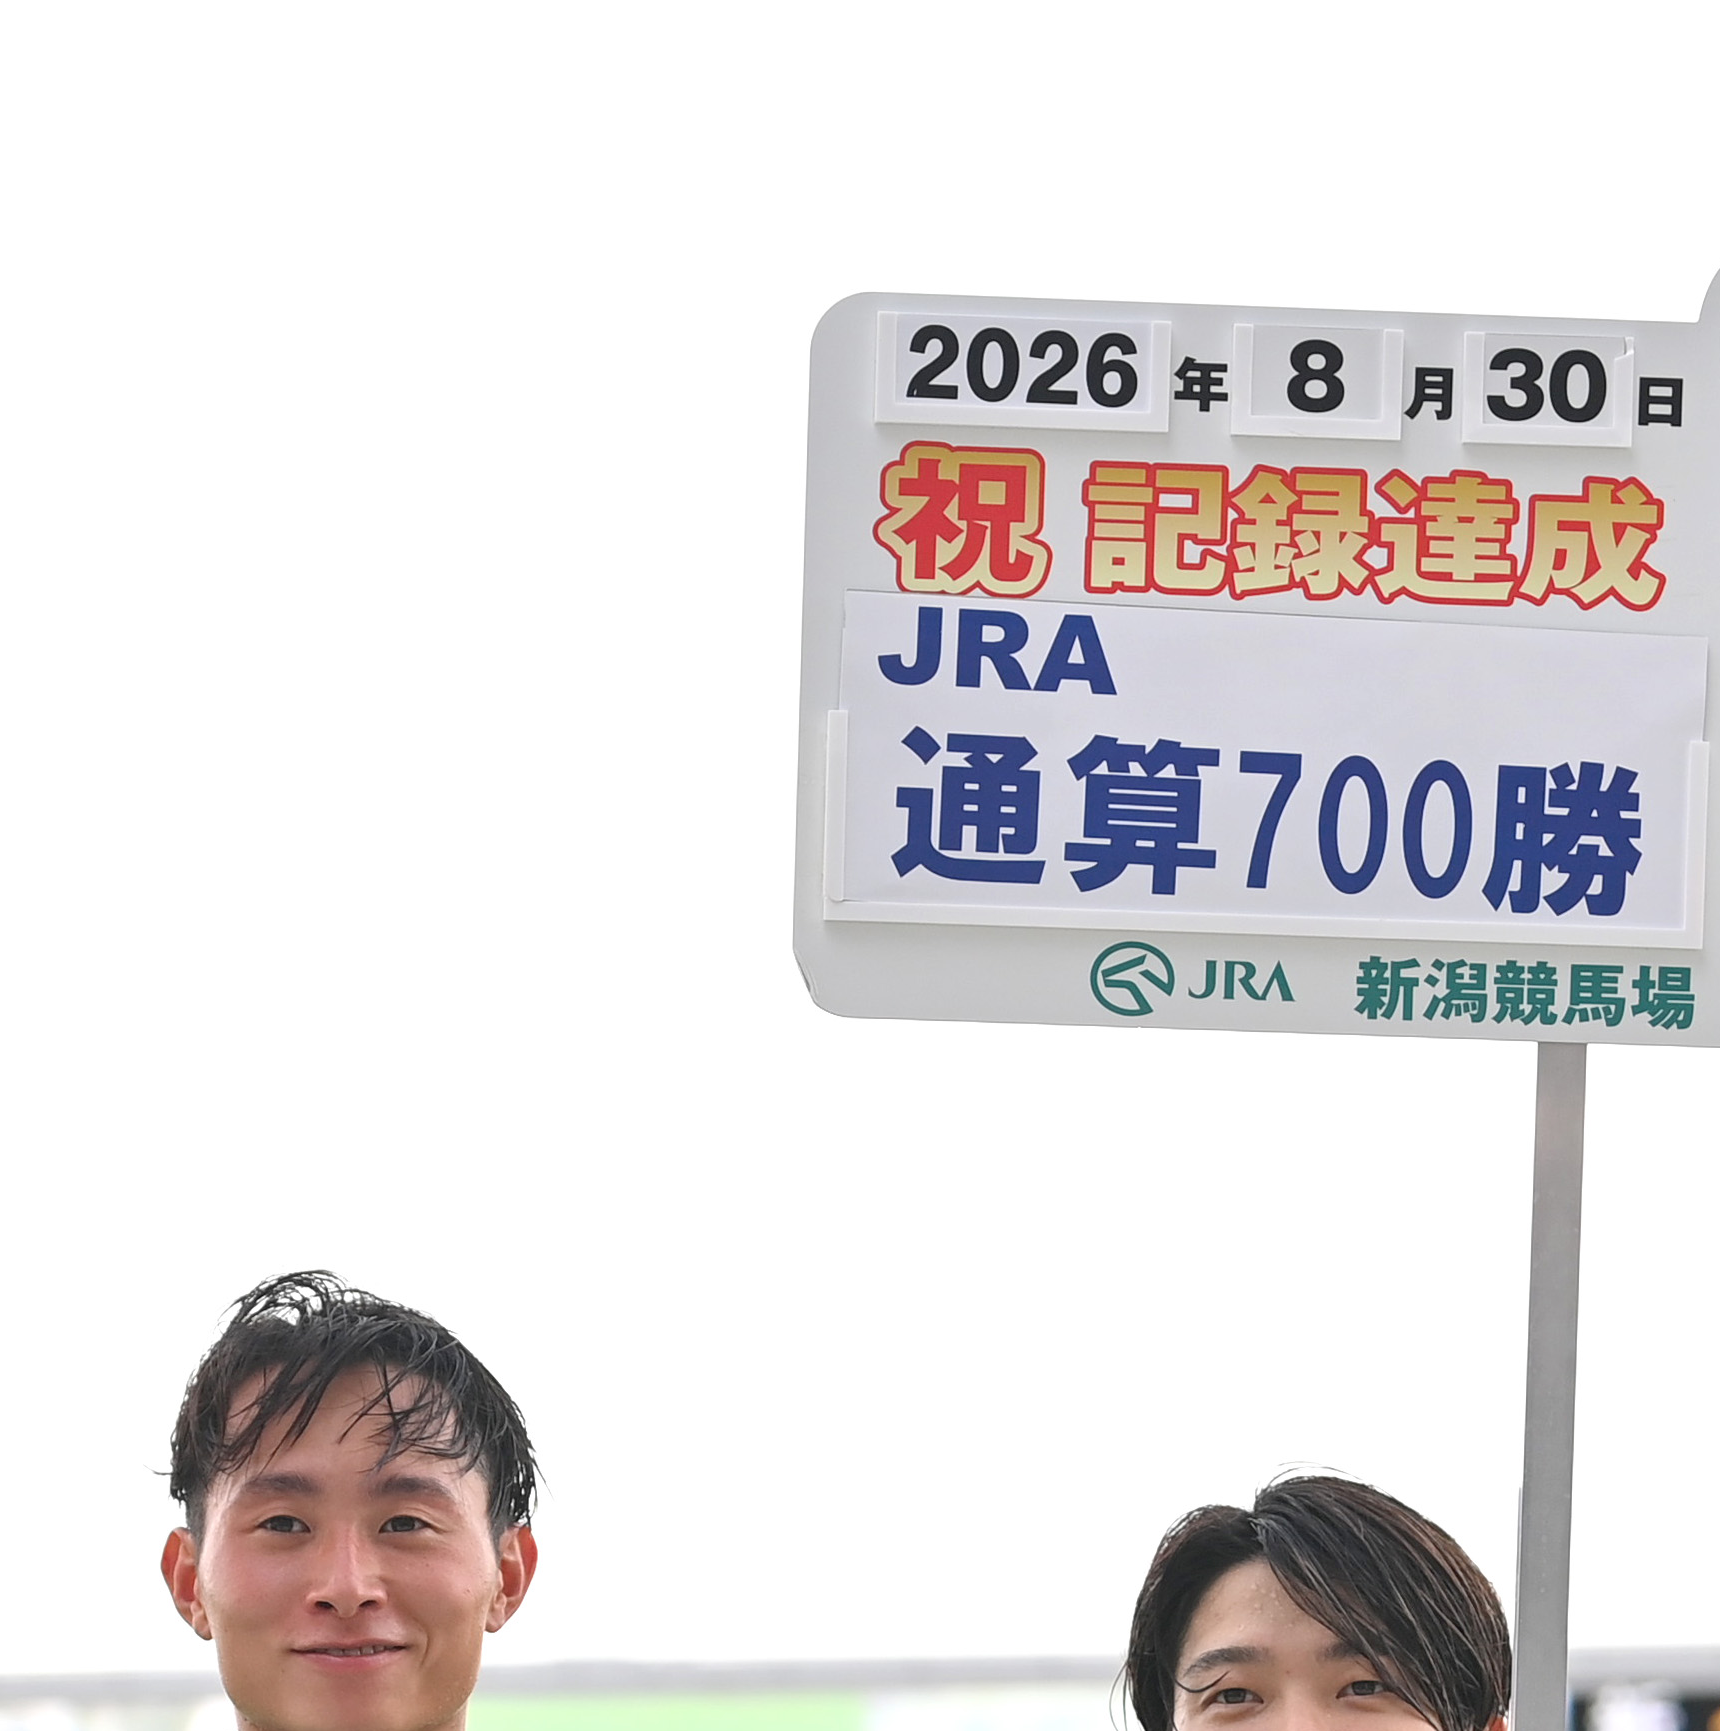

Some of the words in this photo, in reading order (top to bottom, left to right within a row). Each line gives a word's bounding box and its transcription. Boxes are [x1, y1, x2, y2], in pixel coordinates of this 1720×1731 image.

[873, 440, 1052, 600] 祝
[1083, 459, 1665, 612] 記録達成
[877, 606, 1118, 696] JRA
[889, 725, 1643, 917] 通算700勝
[1187, 958, 1297, 1004] JRA
[1355, 954, 1697, 1031] 新潟競馬場
